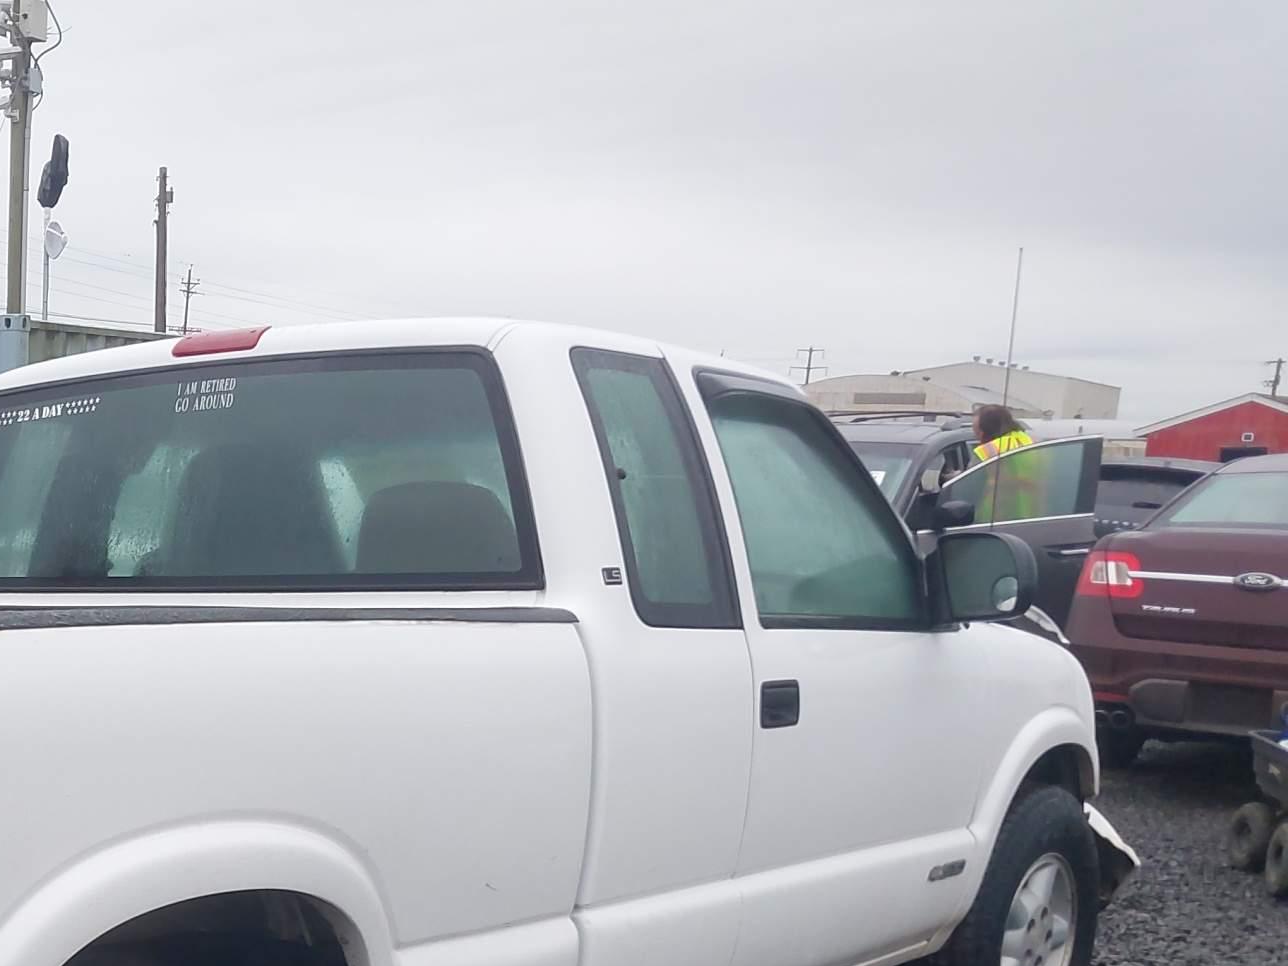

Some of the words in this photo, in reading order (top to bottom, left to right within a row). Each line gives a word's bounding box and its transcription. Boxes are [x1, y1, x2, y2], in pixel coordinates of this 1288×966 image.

[184, 381, 198, 396] AM
[200, 377, 237, 394] RETIRED
[16, 410, 31, 423] 22
[32, 408, 40, 421] A
[42, 403, 65, 419] DAY
[175, 397, 190, 413] GO
[192, 393, 234, 411] AROUND
